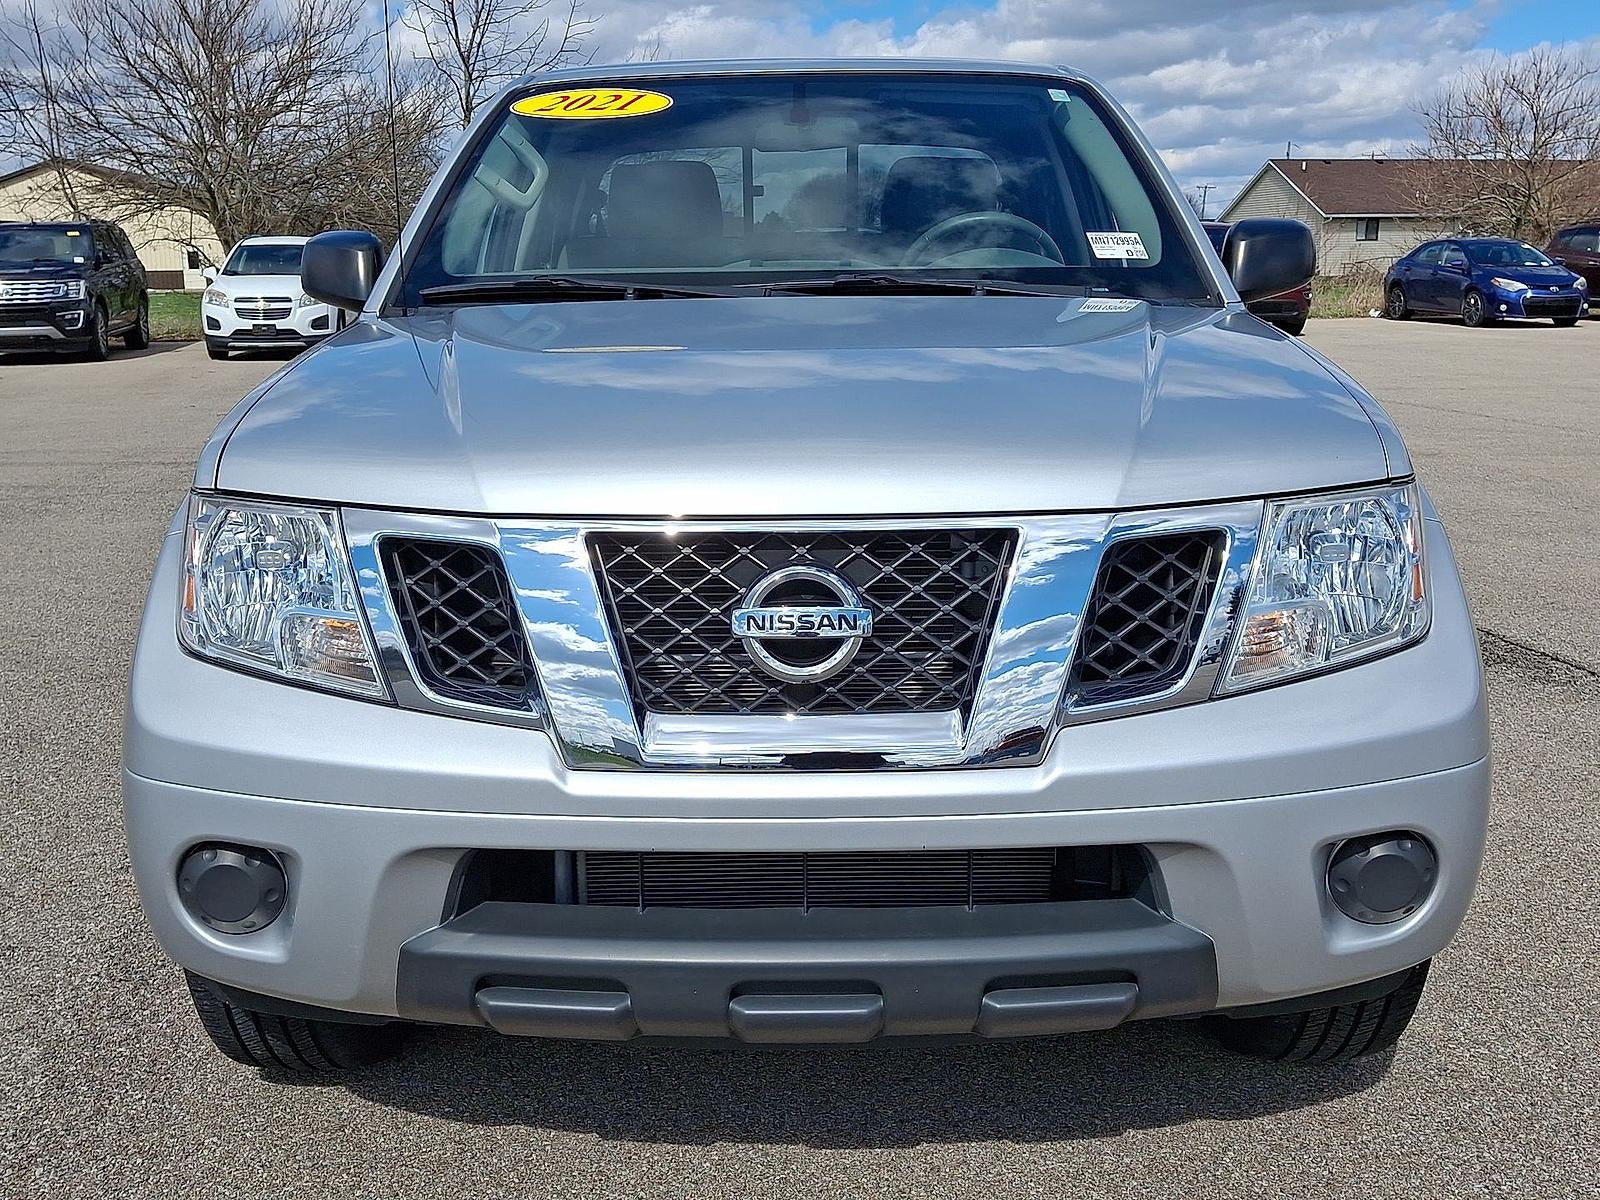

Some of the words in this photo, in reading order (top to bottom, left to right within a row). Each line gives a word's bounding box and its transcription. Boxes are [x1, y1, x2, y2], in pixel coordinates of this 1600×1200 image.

[533, 94, 648, 112] 2021
[1090, 236, 1141, 246] MN712995A
[1126, 249, 1134, 257] D
[746, 613, 858, 631] NISSAN
